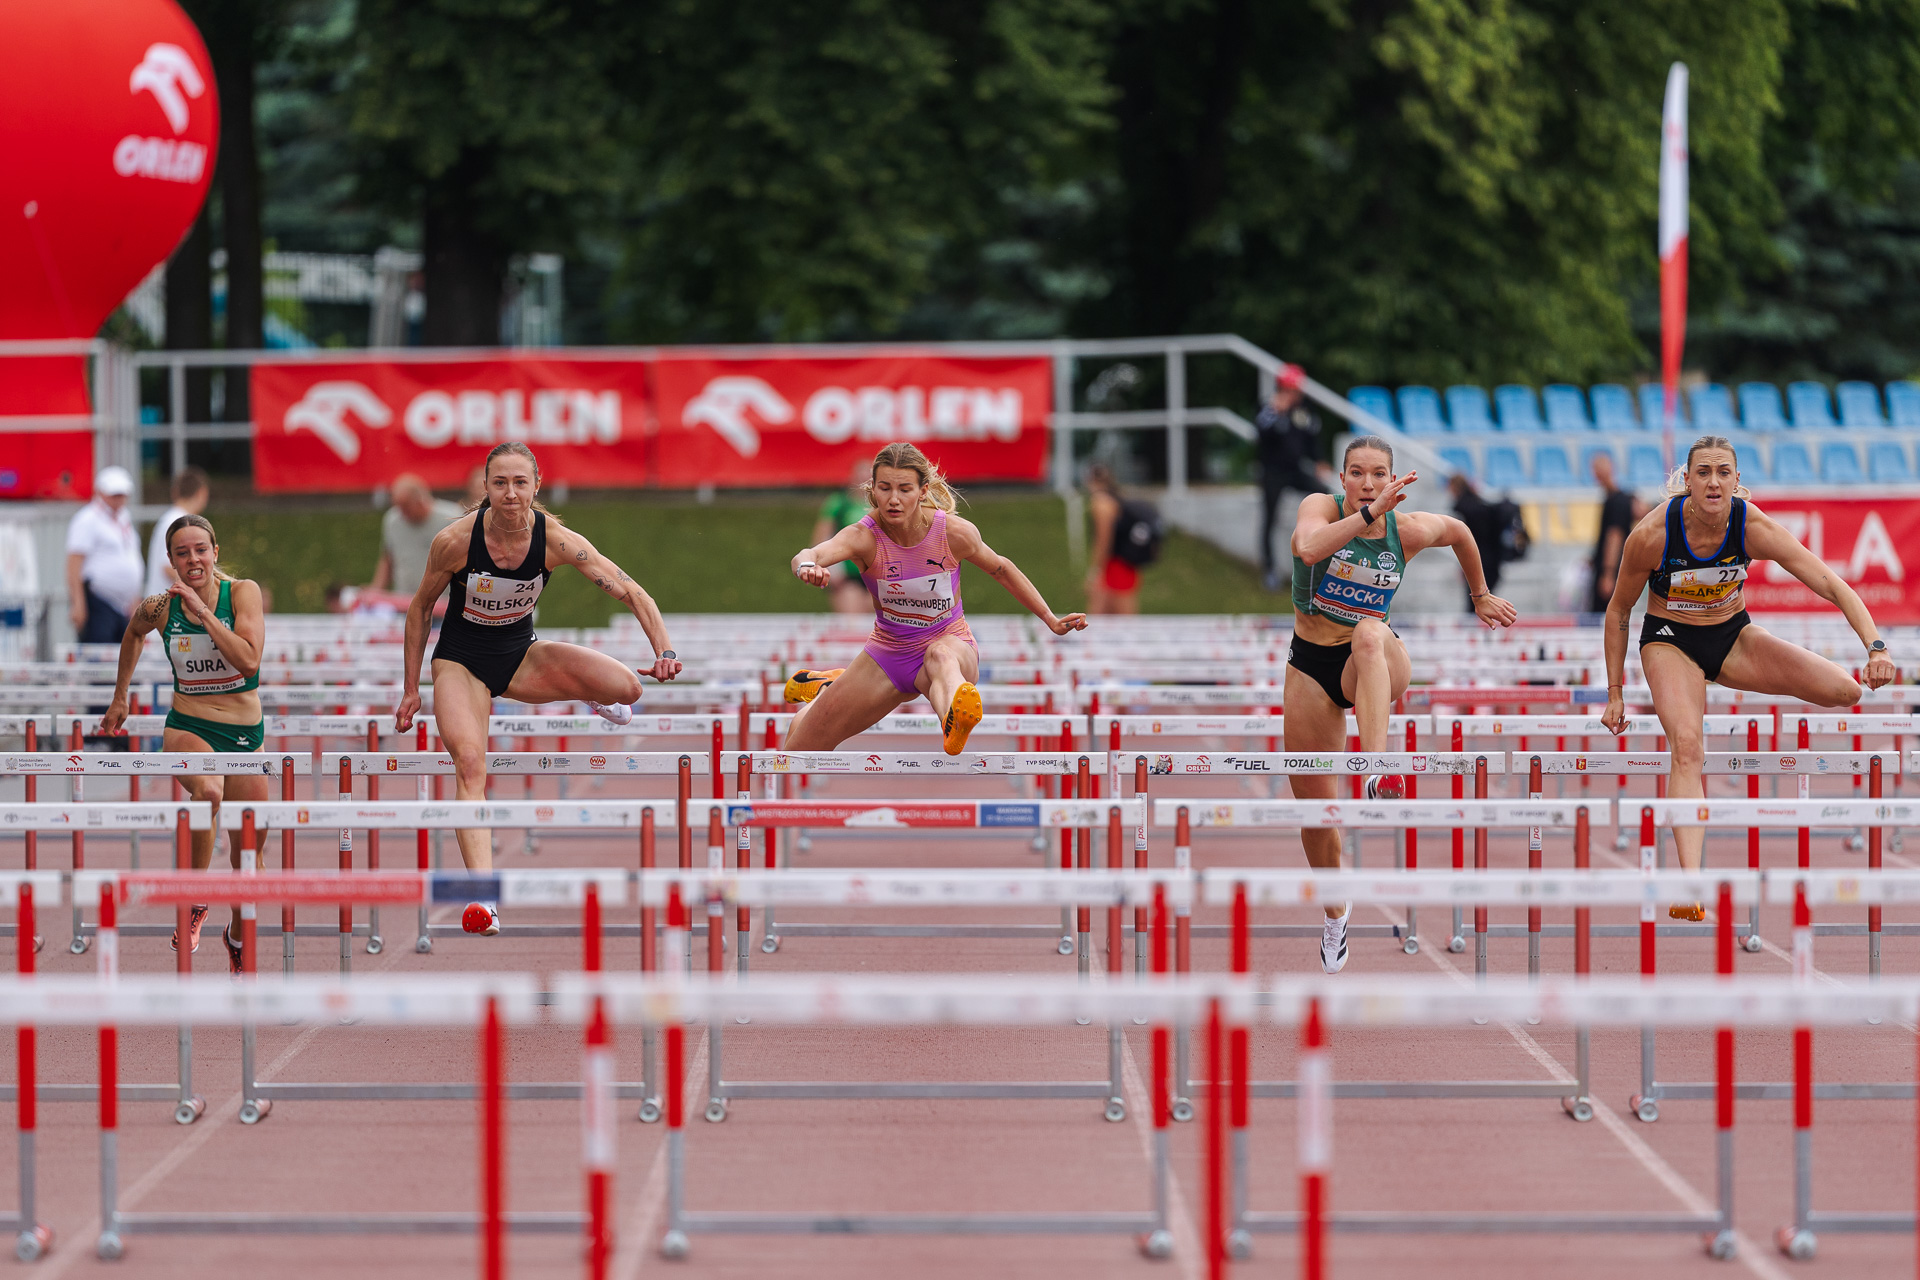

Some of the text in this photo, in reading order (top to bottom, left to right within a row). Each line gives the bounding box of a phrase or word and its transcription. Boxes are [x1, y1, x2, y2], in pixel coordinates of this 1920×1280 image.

[113, 134, 207, 184] ORLEN
[404, 389, 623, 448] ORLEN
[804, 385, 1023, 444] ORLEN
[1372, 573, 1391, 587] 15
[1718, 569, 1739, 582] 27
[515, 582, 535, 593] 24
[928, 579, 937, 591] 7
[1324, 582, 1385, 606] SŁOCKA
[472, 597, 534, 611] BIELSKA
[1320, 604, 1359, 620] WARSZAWA
[472, 616, 512, 625] WARSZAWA
[891, 616, 929, 627] WARSZAWA
[186, 658, 227, 673] SURA
[221, 682, 237, 690] 2025
[1235, 761, 1270, 770] FUEL
[1284, 758, 1334, 768] TOTALbet
